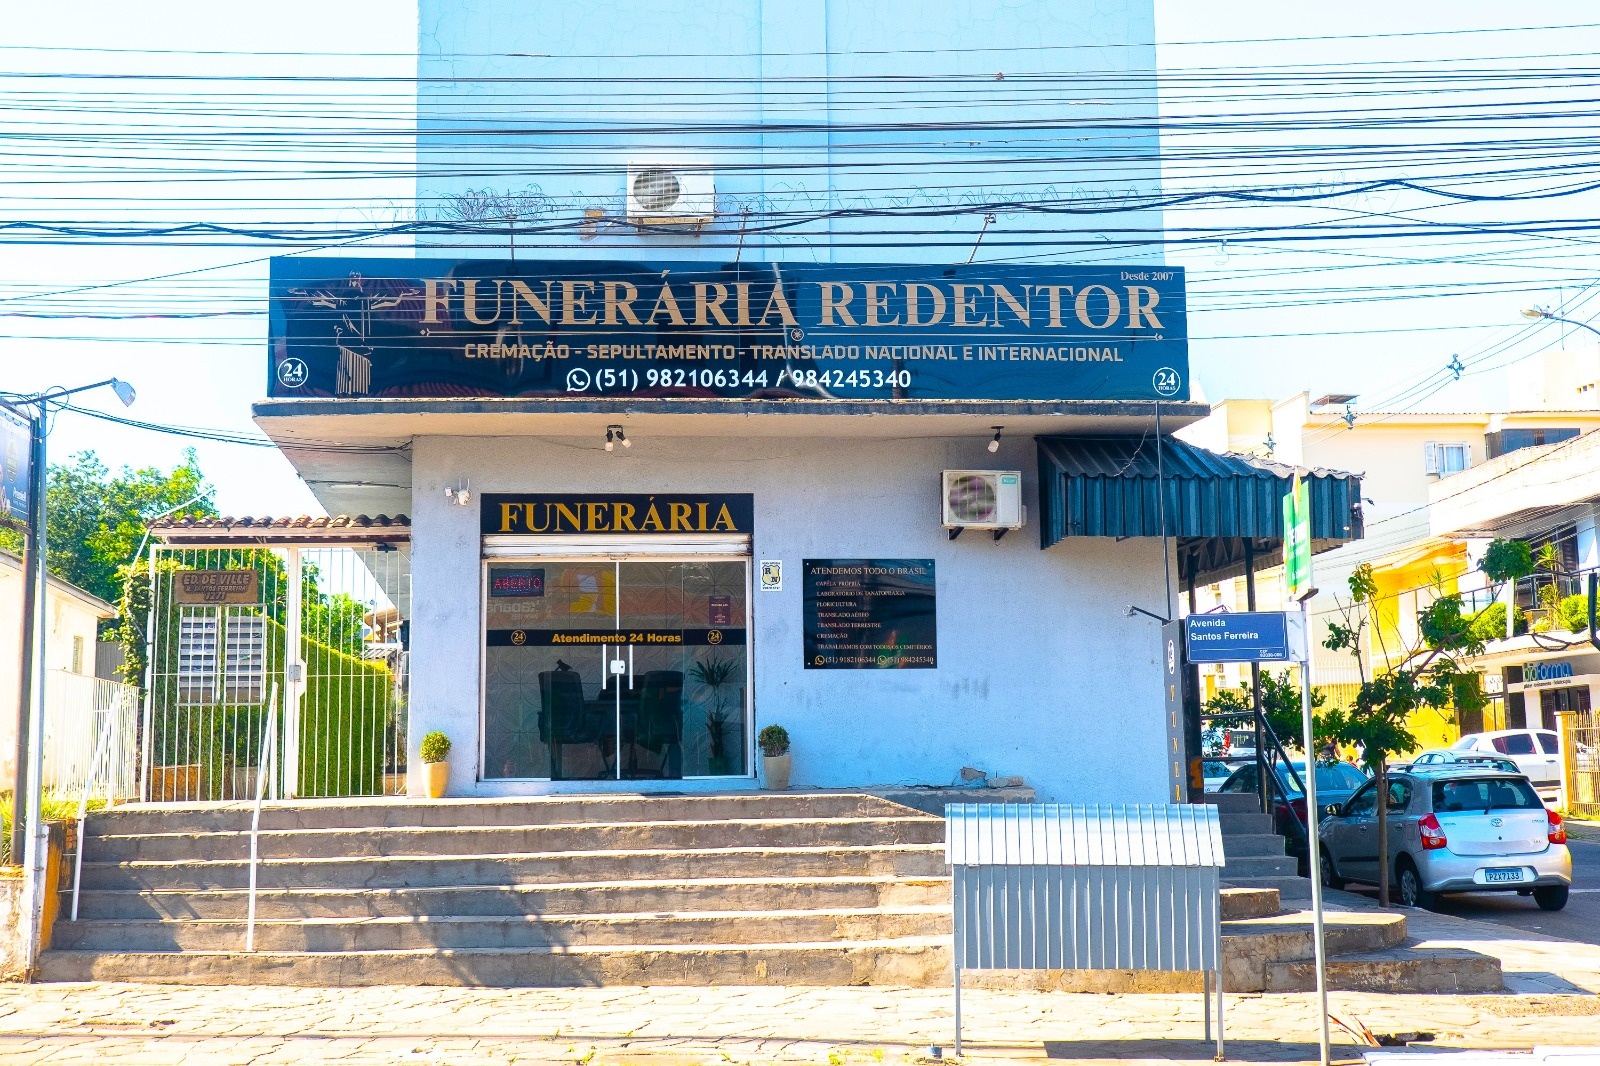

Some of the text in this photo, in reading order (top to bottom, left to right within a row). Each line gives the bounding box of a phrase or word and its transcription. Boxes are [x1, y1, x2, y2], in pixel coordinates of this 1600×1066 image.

[1120, 271, 1174, 281] Desde 2007
[418, 269, 1165, 330] FUNERÁRIA REDENTOR
[464, 341, 570, 363] CREMAÇÃO
[587, 344, 735, 360] SEPULTAMENTO
[750, 344, 859, 361] TRANSLADO
[865, 345, 957, 361] NACIONAL
[963, 346, 973, 361] E
[978, 346, 1124, 362] INTERNACIONAL
[283, 362, 303, 377] 24
[595, 368, 638, 391] (51)
[646, 369, 768, 388] 982106344
[792, 369, 912, 388] 984245340
[1157, 372, 1176, 386] 24
[498, 495, 738, 532] FUNERÁRIA
[810, 567, 927, 575] ATENDEMOS TODO O BRASIL
[201, 574, 217, 585] DE
[220, 574, 250, 585] VILLE
[494, 577, 542, 590] ABERTO
[1190, 619, 1226, 628] Avenida
[514, 632, 524, 640] 24
[551, 632, 682, 643] Atendimento 24 Horas
[710, 632, 720, 640] 24
[1190, 631, 1259, 641] Santos Ferreira
[825, 656, 839, 664] (51)
